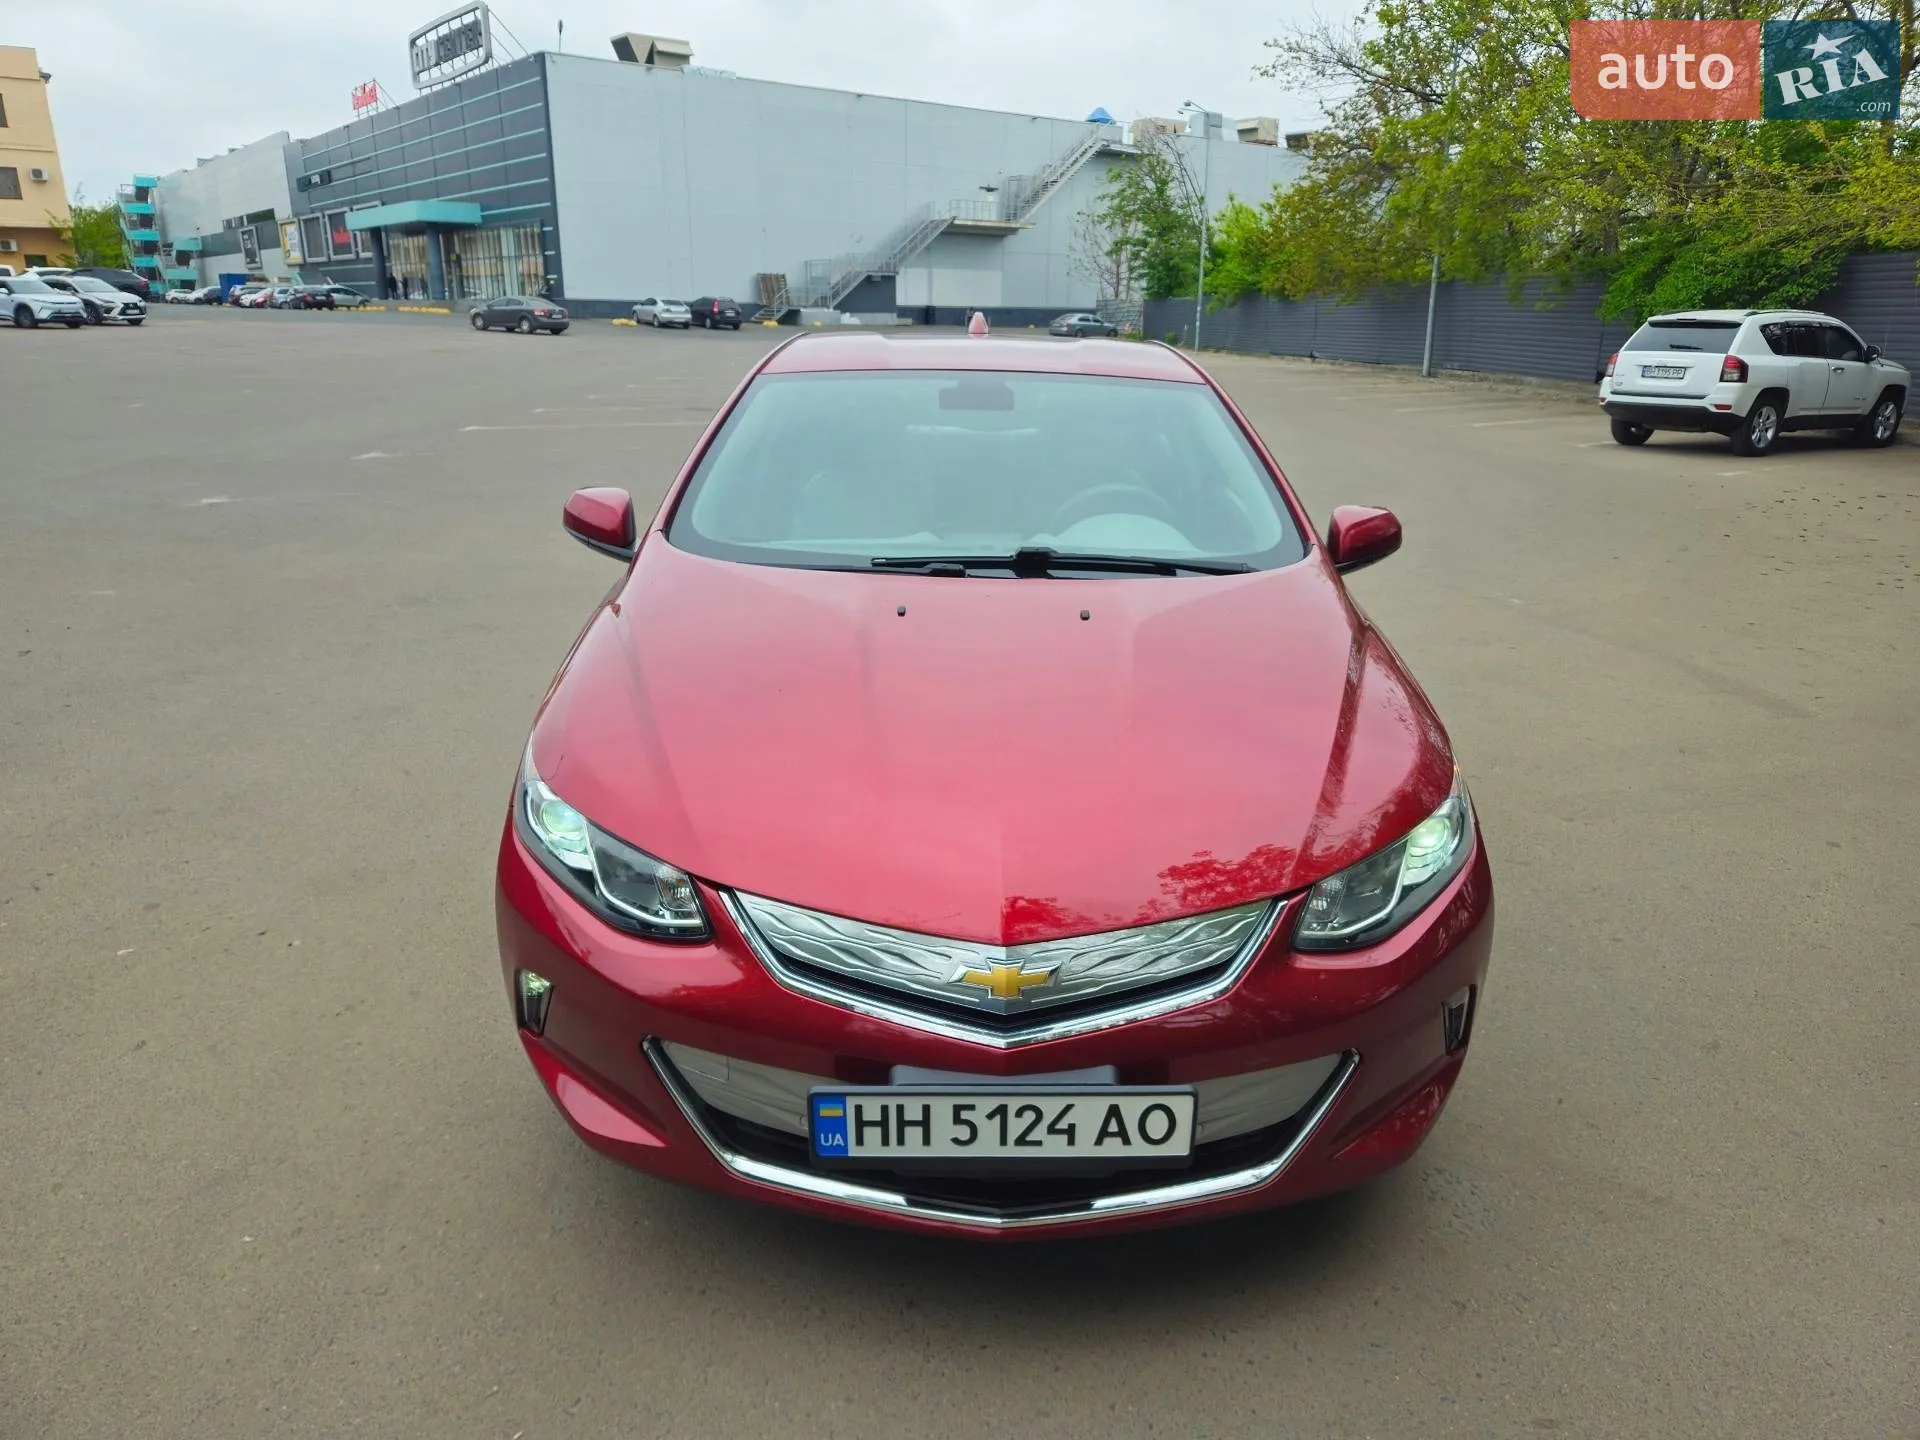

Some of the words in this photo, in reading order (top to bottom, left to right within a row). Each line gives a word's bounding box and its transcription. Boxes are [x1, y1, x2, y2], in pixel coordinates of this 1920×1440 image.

[820, 1132, 845, 1147] UA
[854, 1104, 931, 1147] HH
[950, 1104, 1076, 1147] 5124
[1093, 1104, 1178, 1147] AO
